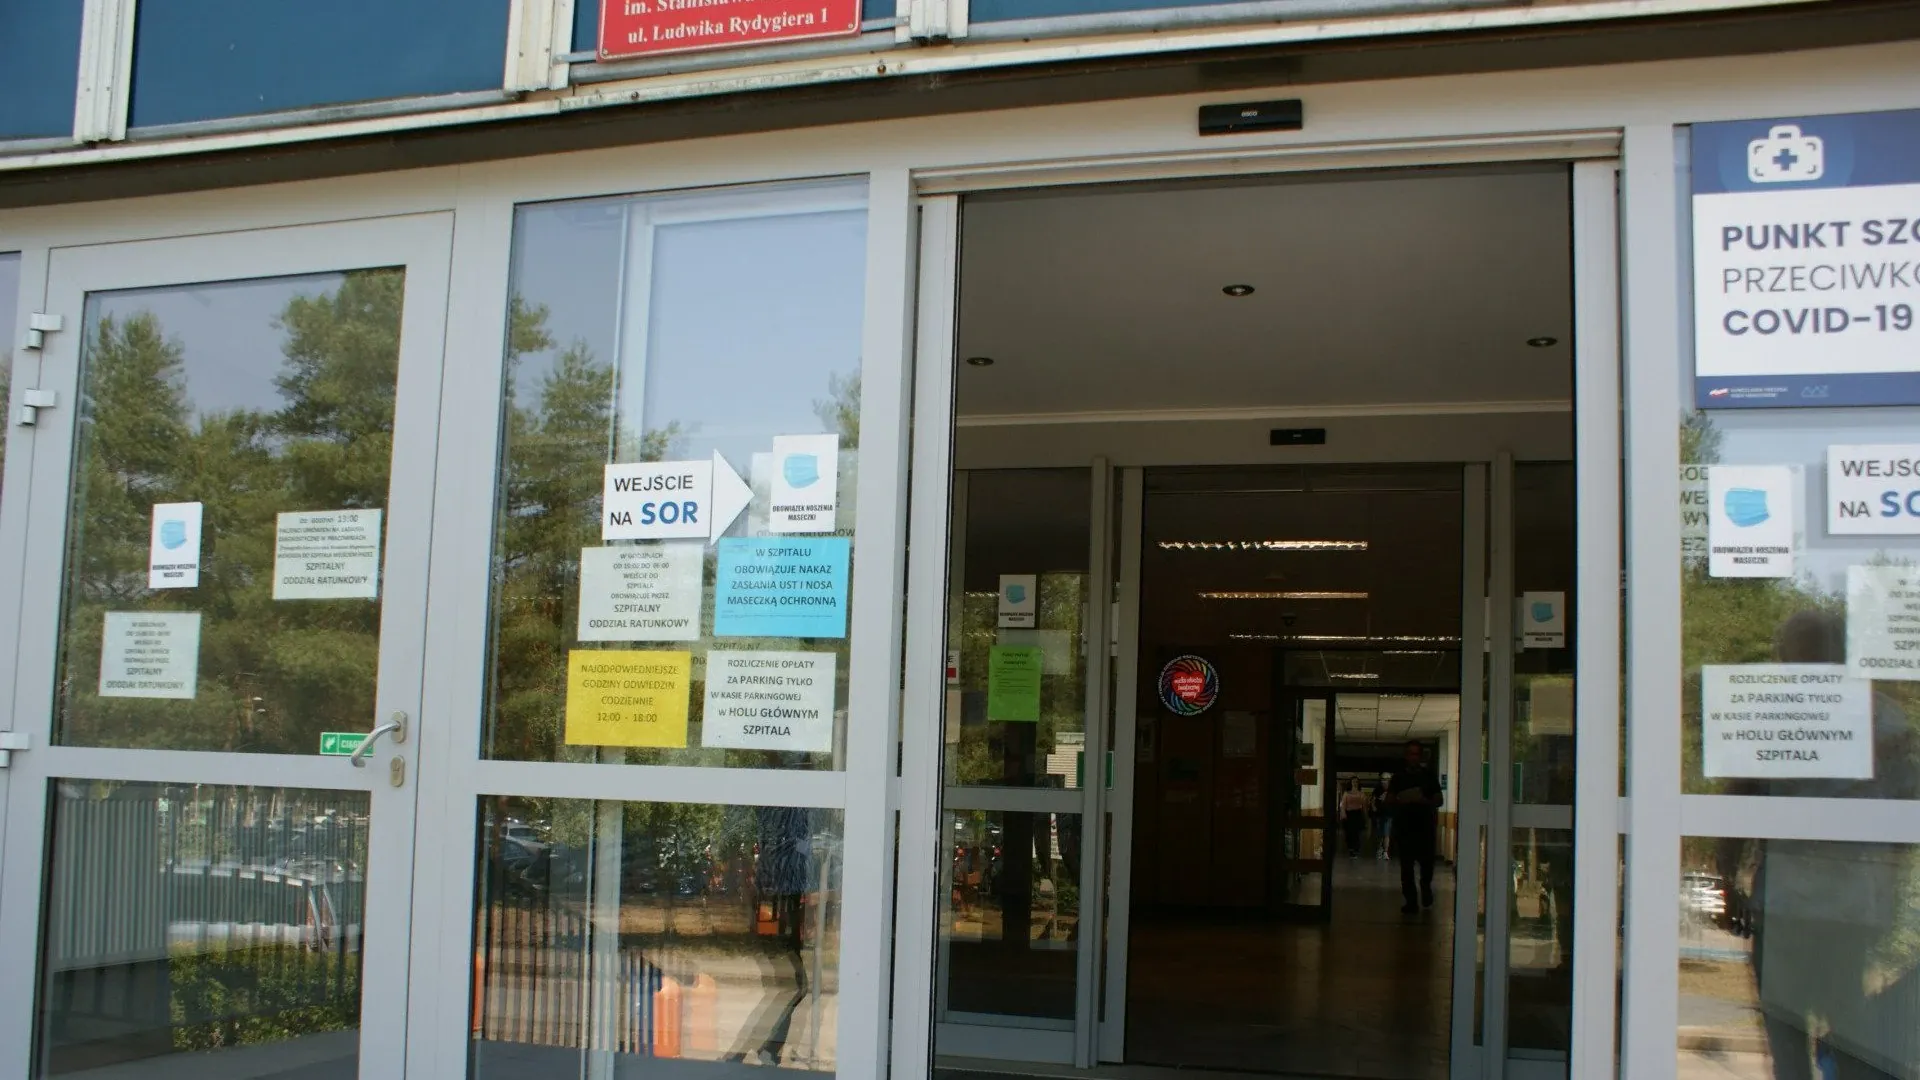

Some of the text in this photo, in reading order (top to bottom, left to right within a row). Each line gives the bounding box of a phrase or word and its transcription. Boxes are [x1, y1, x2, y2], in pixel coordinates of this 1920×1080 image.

[624, 0, 755, 16] im. Stanisa
[628, 7, 828, 44] ul. Ludwika Rydygiera 1
[1722, 220, 1851, 251] PUNKT
[1723, 303, 1913, 336] COVID-19
[614, 474, 694, 492] WEJŚCIE
[610, 501, 698, 526] NA SOR
[1839, 500, 1871, 518] NA
[755, 548, 812, 557] W SZPITALU
[305, 562, 345, 571] SZPITALNY
[734, 565, 832, 576] OBOWIĄZUJE NAKAZ
[731, 580, 777, 590] ZASŁANIA
[779, 580, 797, 589] UST
[805, 581, 833, 590] NOSA
[727, 596, 837, 607] MASECZKĄ OCHRONNĄ
[614, 604, 661, 613] SZPITALNY
[589, 619, 689, 628] ODDZIAŁ RATUNKOWY
[581, 664, 679, 675] NAJODPOWIEDNIEJSZE
[727, 659, 815, 669] ROZLICZENIE OPŁATY
[582, 679, 676, 690] GODZINY ODWIEDZIN
[727, 675, 813, 687] ZA PARKING TYLKO
[1728, 674, 1844, 684] ROZLICZENIE OPŁATY
[601, 696, 654, 706] CODZIENNIE
[720, 691, 742, 700] KASIE
[744, 691, 802, 701] PARKINGOWEJ
[1730, 693, 1843, 704] ZA PARKING TYLKO
[728, 707, 758, 718] HOLU
[760, 706, 819, 719] GŁÓWNYM
[1723, 712, 1752, 721] KASIE
[1754, 712, 1831, 722] PARKINGOWEJ
[743, 724, 791, 736] SZPITALA
[1736, 729, 1774, 741] HOLU
[1777, 727, 1854, 741] GŁÓWNYM
[1755, 749, 1820, 761] SZPITALA
